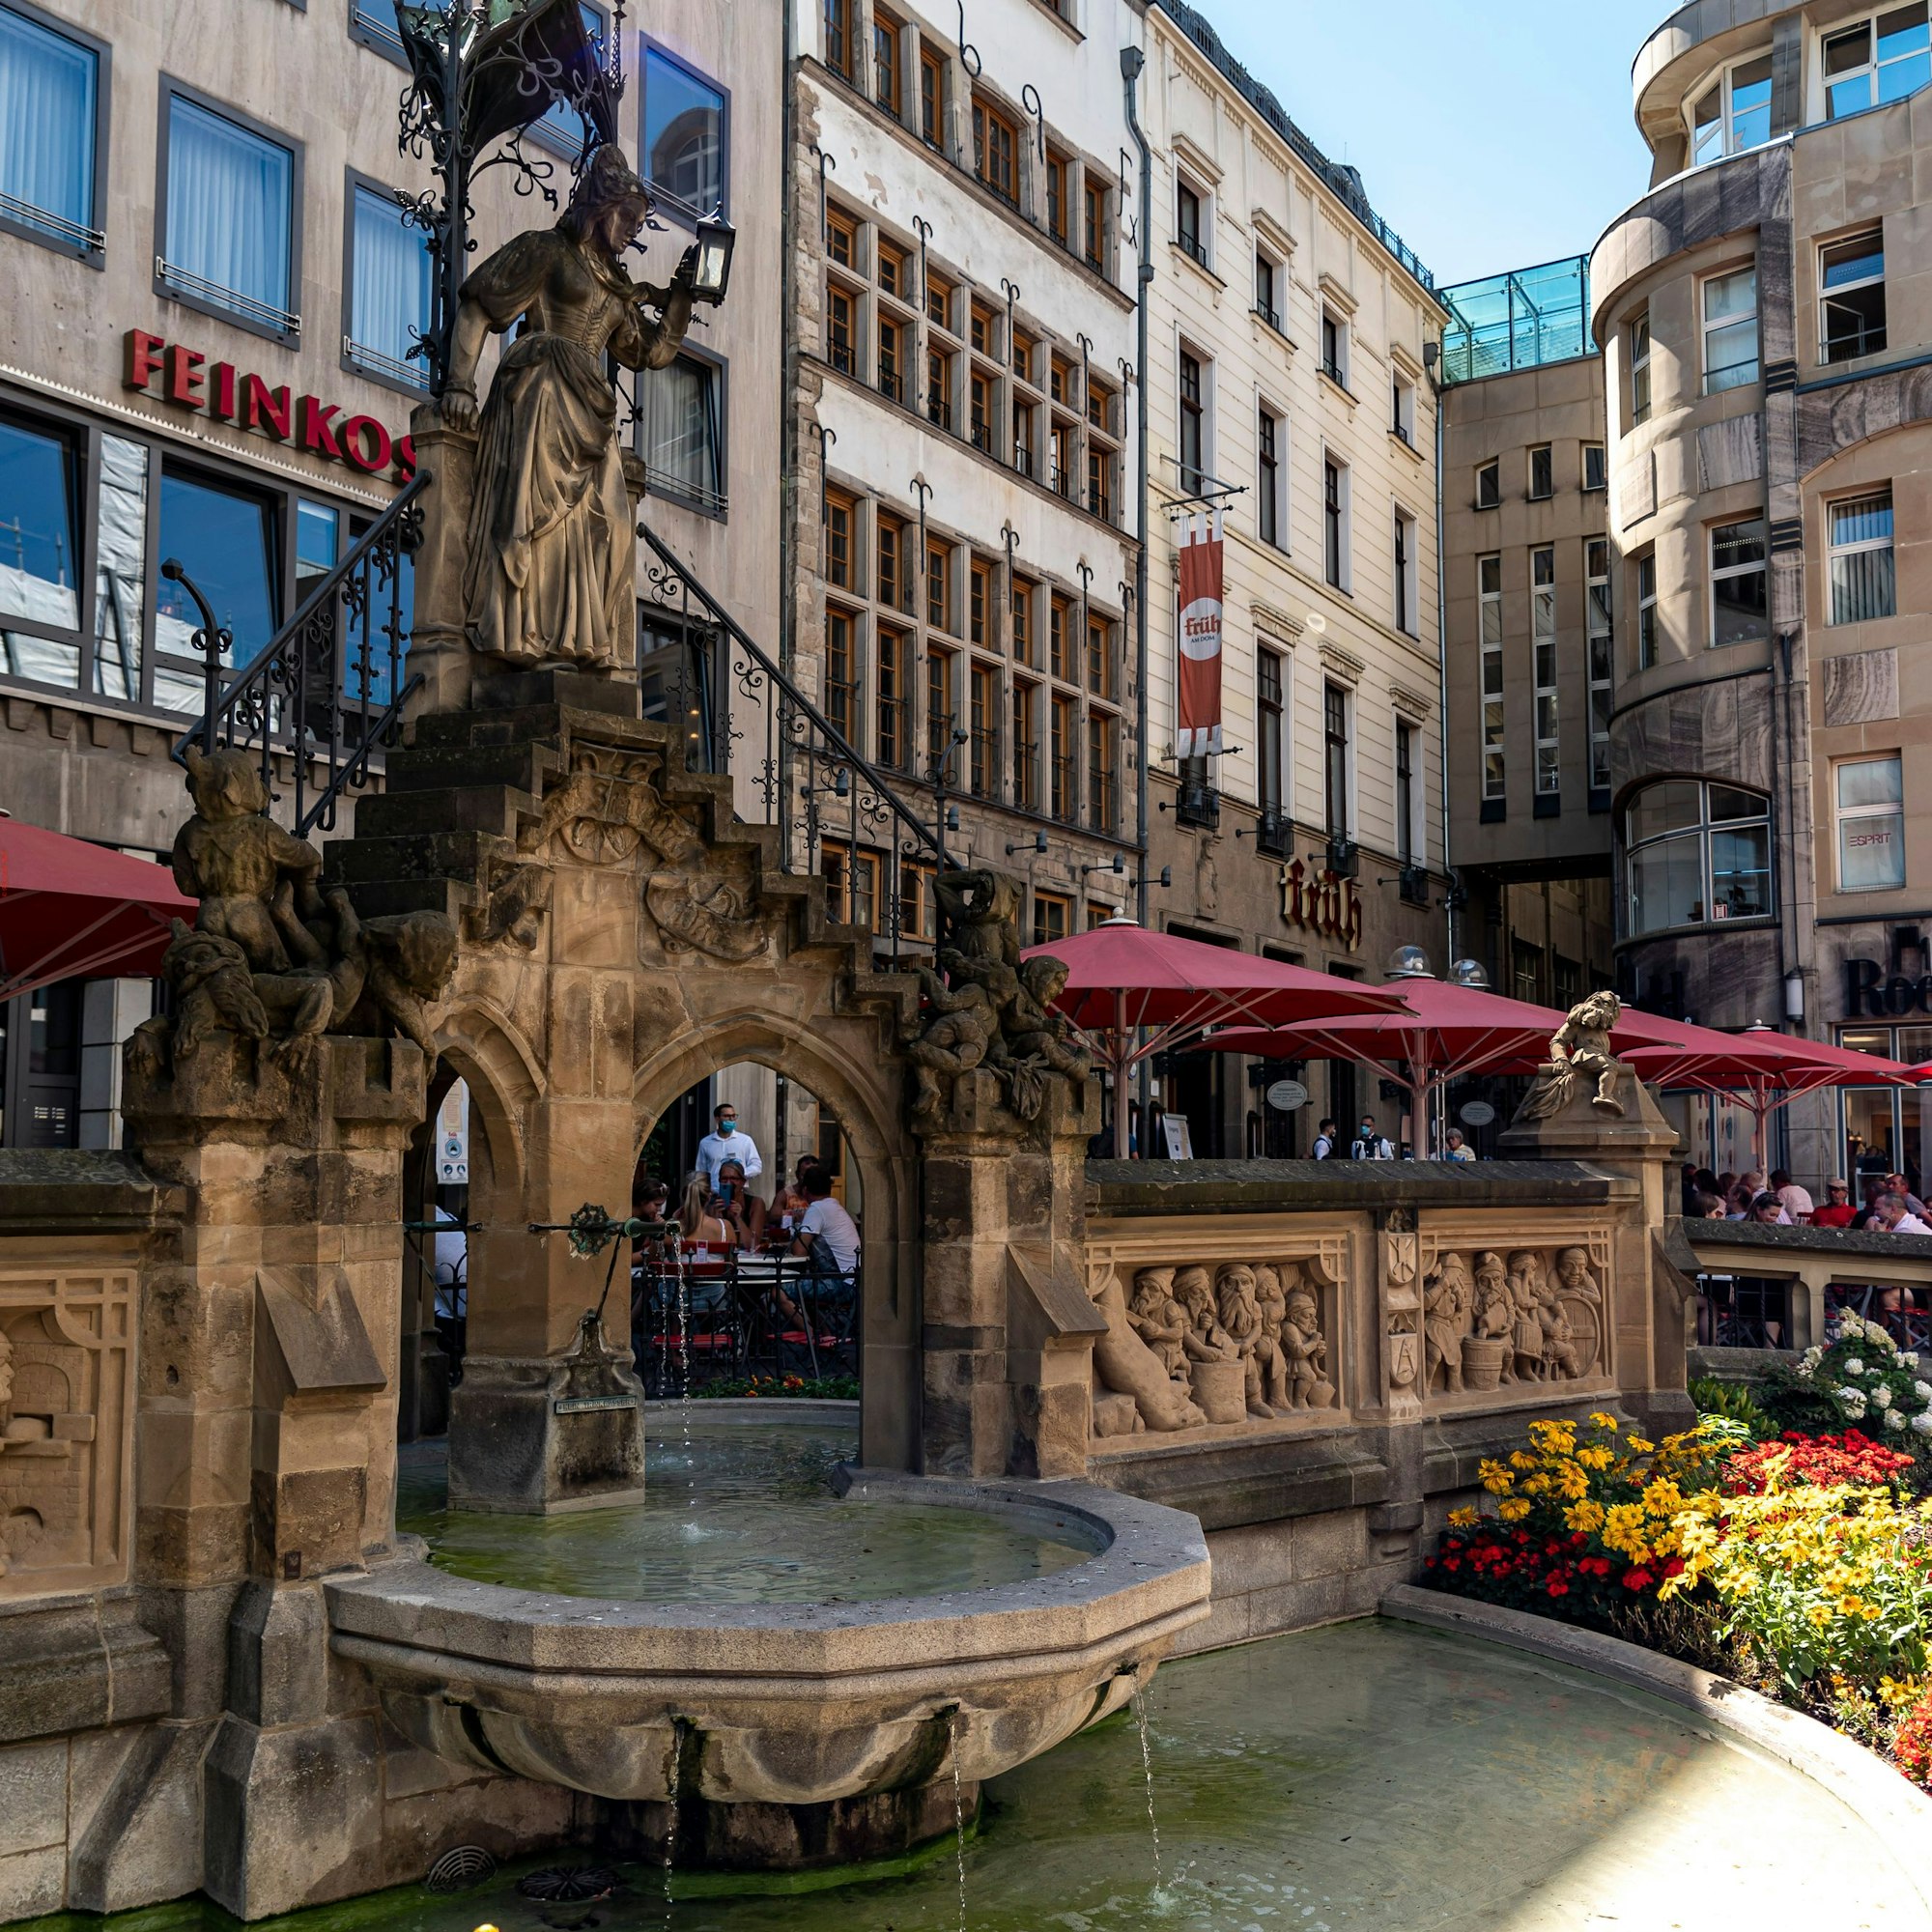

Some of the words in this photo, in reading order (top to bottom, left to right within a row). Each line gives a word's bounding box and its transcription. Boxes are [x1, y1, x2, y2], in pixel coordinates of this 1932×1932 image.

[1184, 613, 1221, 637] früh
[1849, 833, 1891, 847] ESPRIT
[1280, 858, 1362, 952] früh
